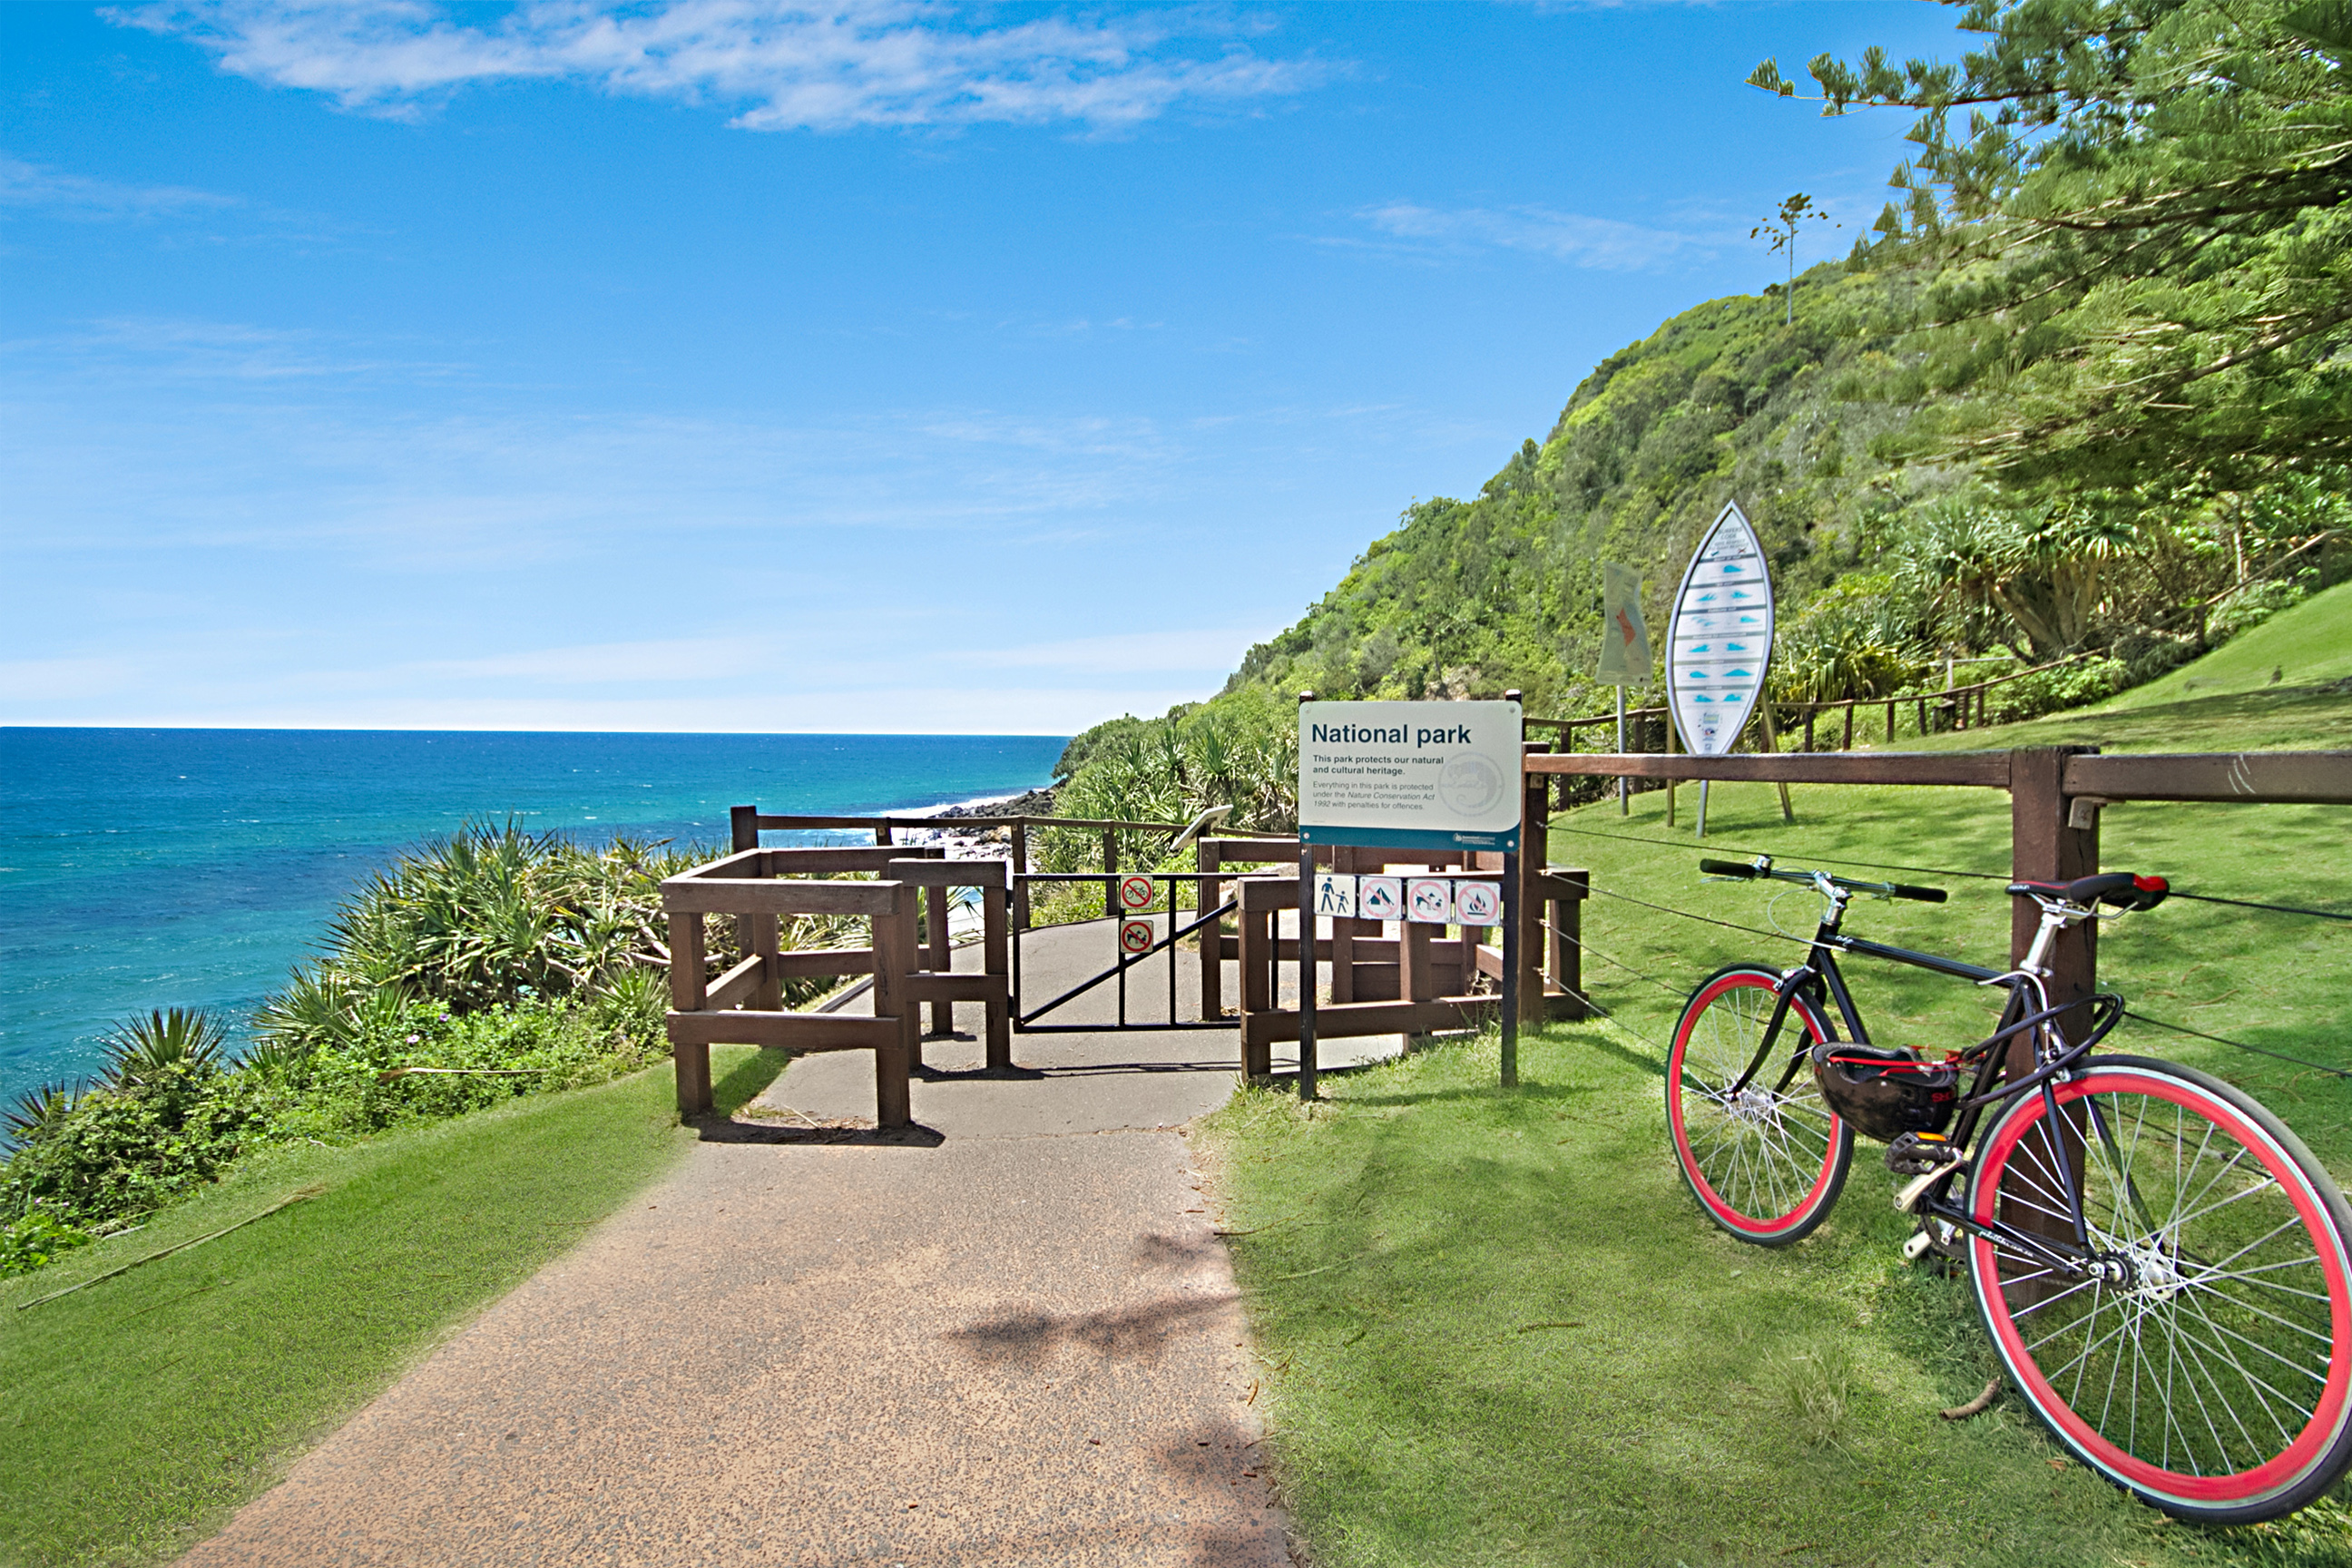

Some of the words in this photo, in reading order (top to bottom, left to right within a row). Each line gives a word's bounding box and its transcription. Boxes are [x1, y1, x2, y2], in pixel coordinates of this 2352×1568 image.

[1311, 724, 1408, 743] National
[1417, 724, 1472, 748] park
[1313, 755, 1331, 763] This
[1334, 755, 1353, 764] park
[1356, 756, 1391, 765] protects
[1313, 766, 1329, 774] and
[1367, 767, 1406, 776] heritage.
[1313, 781, 1349, 789] Everything
[1348, 801, 1379, 809] penalties
